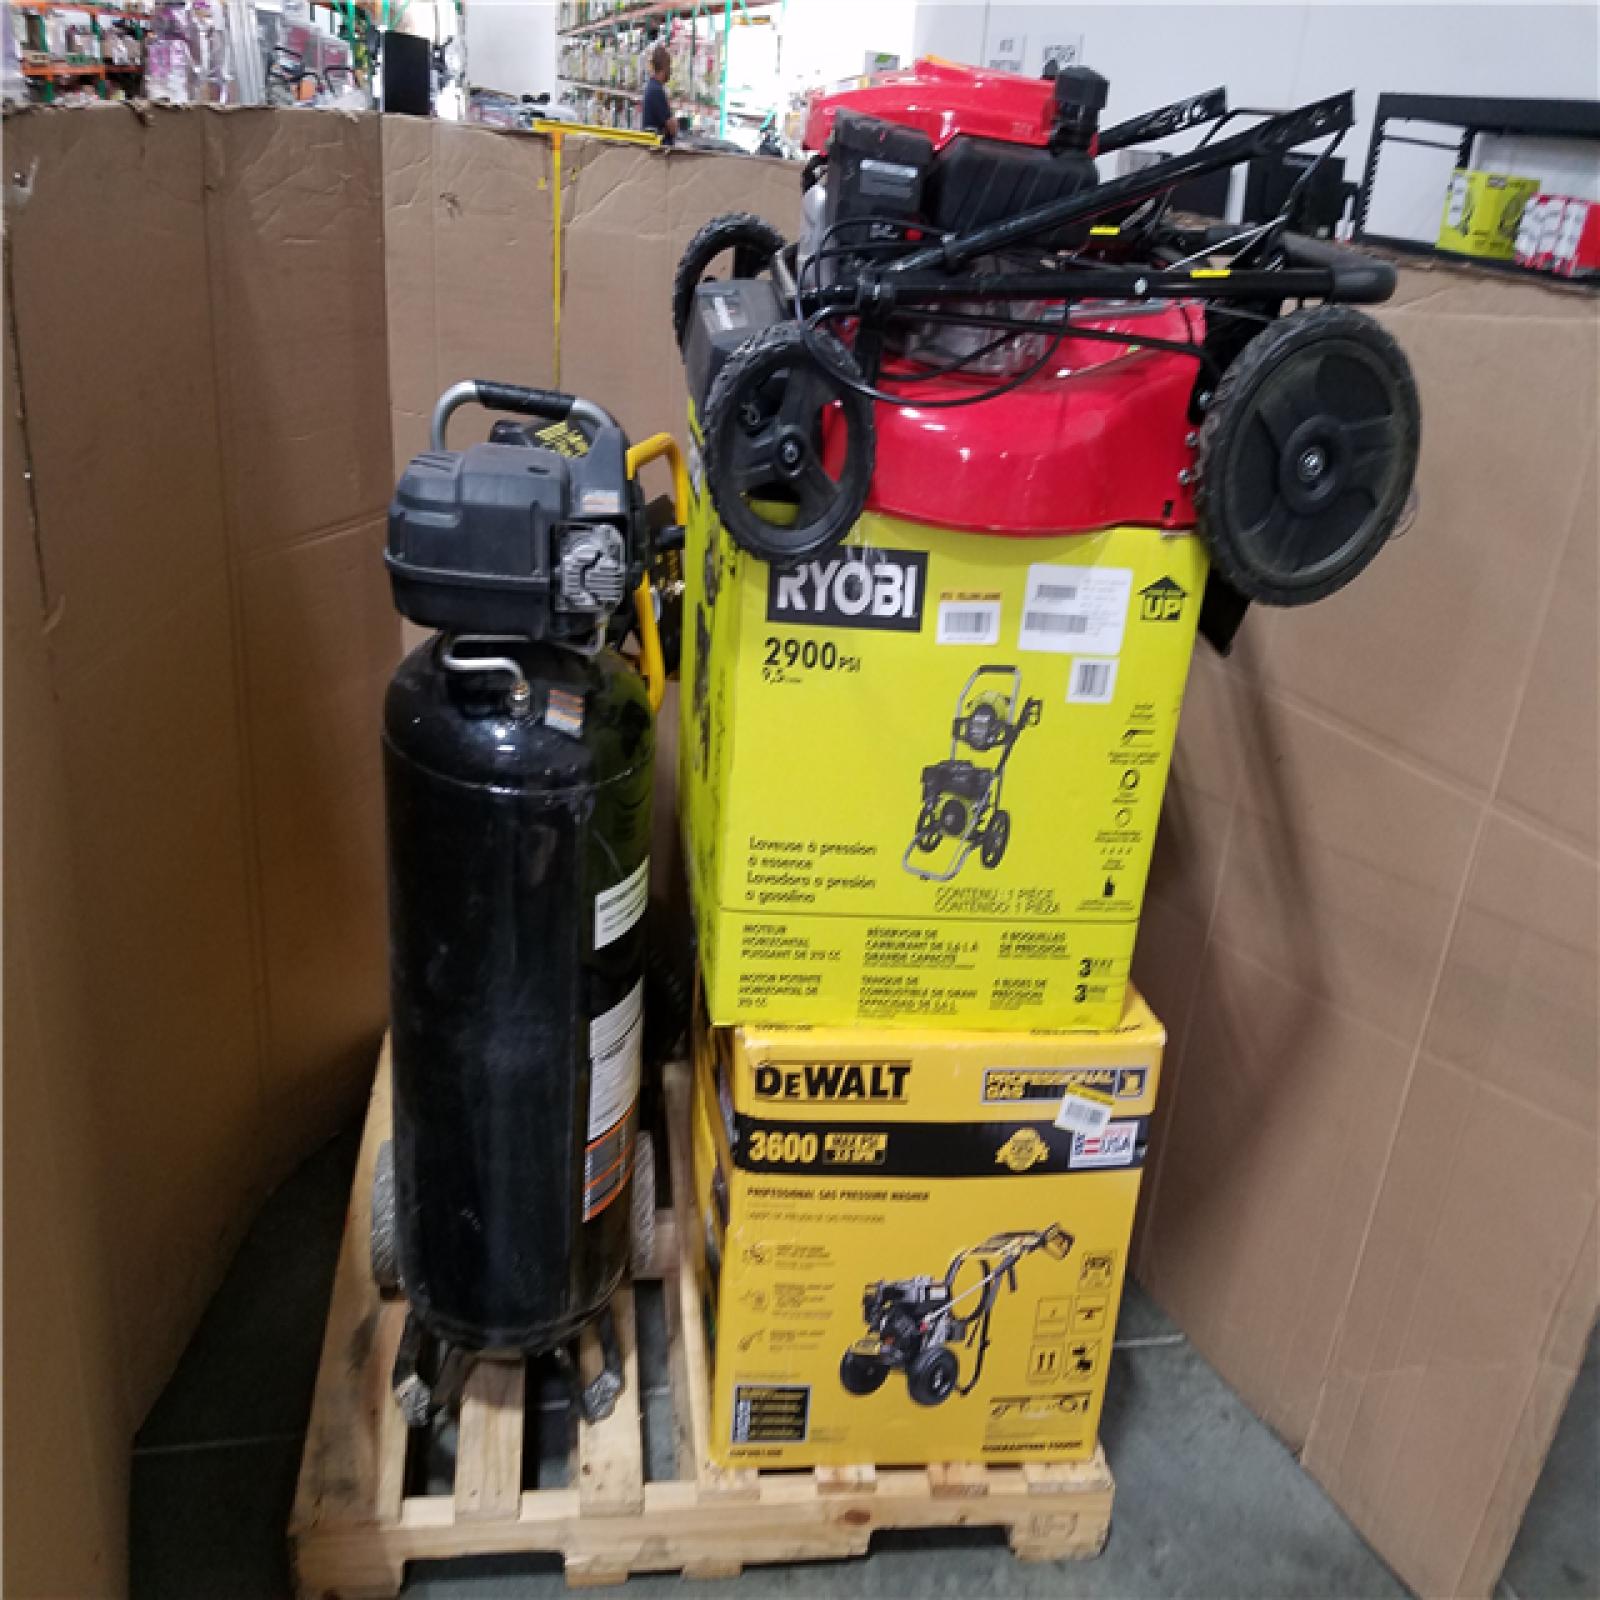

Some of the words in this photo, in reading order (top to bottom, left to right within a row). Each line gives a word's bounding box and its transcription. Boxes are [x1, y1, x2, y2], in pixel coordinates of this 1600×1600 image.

[776, 559, 918, 618] RYOBI
[1145, 596, 1182, 620] UP
[764, 637, 836, 670] 2900
[1079, 958, 1092, 978] 3
[1075, 984, 1088, 1003] 3
[748, 1129, 819, 1164] 3600
